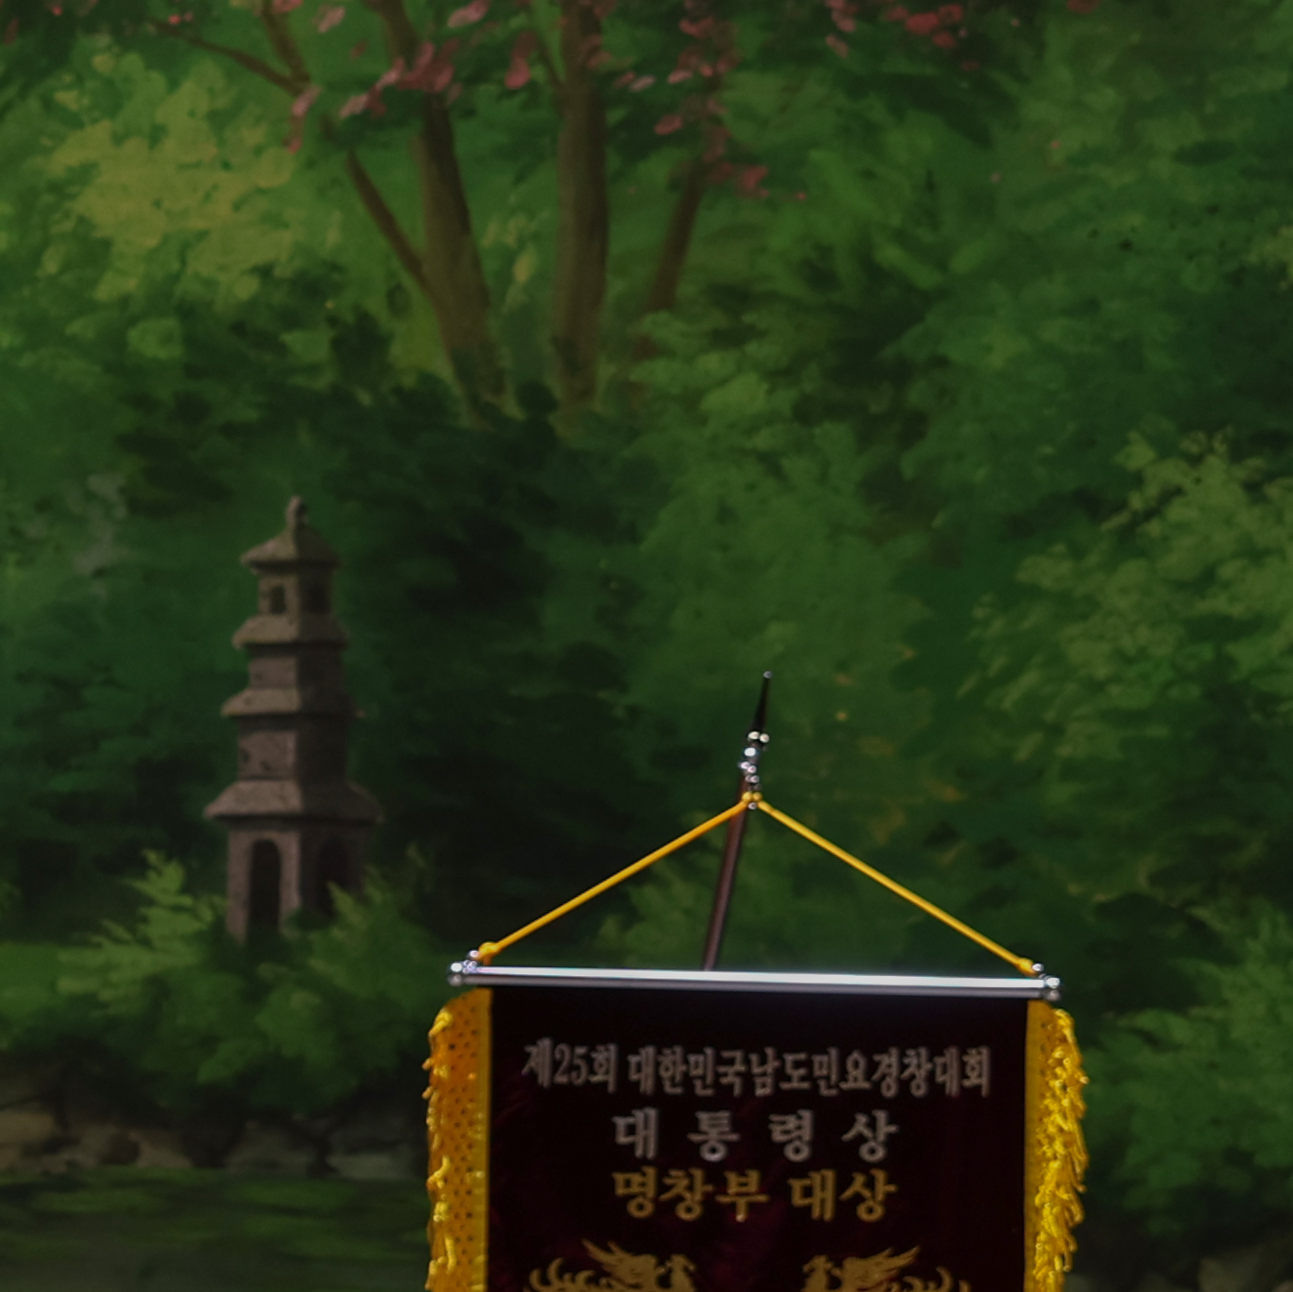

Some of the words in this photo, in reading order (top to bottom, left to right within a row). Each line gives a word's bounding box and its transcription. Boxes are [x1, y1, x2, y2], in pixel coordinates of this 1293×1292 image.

[522, 1036, 617, 1093] 제25회
[627, 1044, 992, 1097] 대한민국남도민요경창대회
[612, 1166, 770, 1222] 명창부
[787, 1168, 899, 1223] 대상
